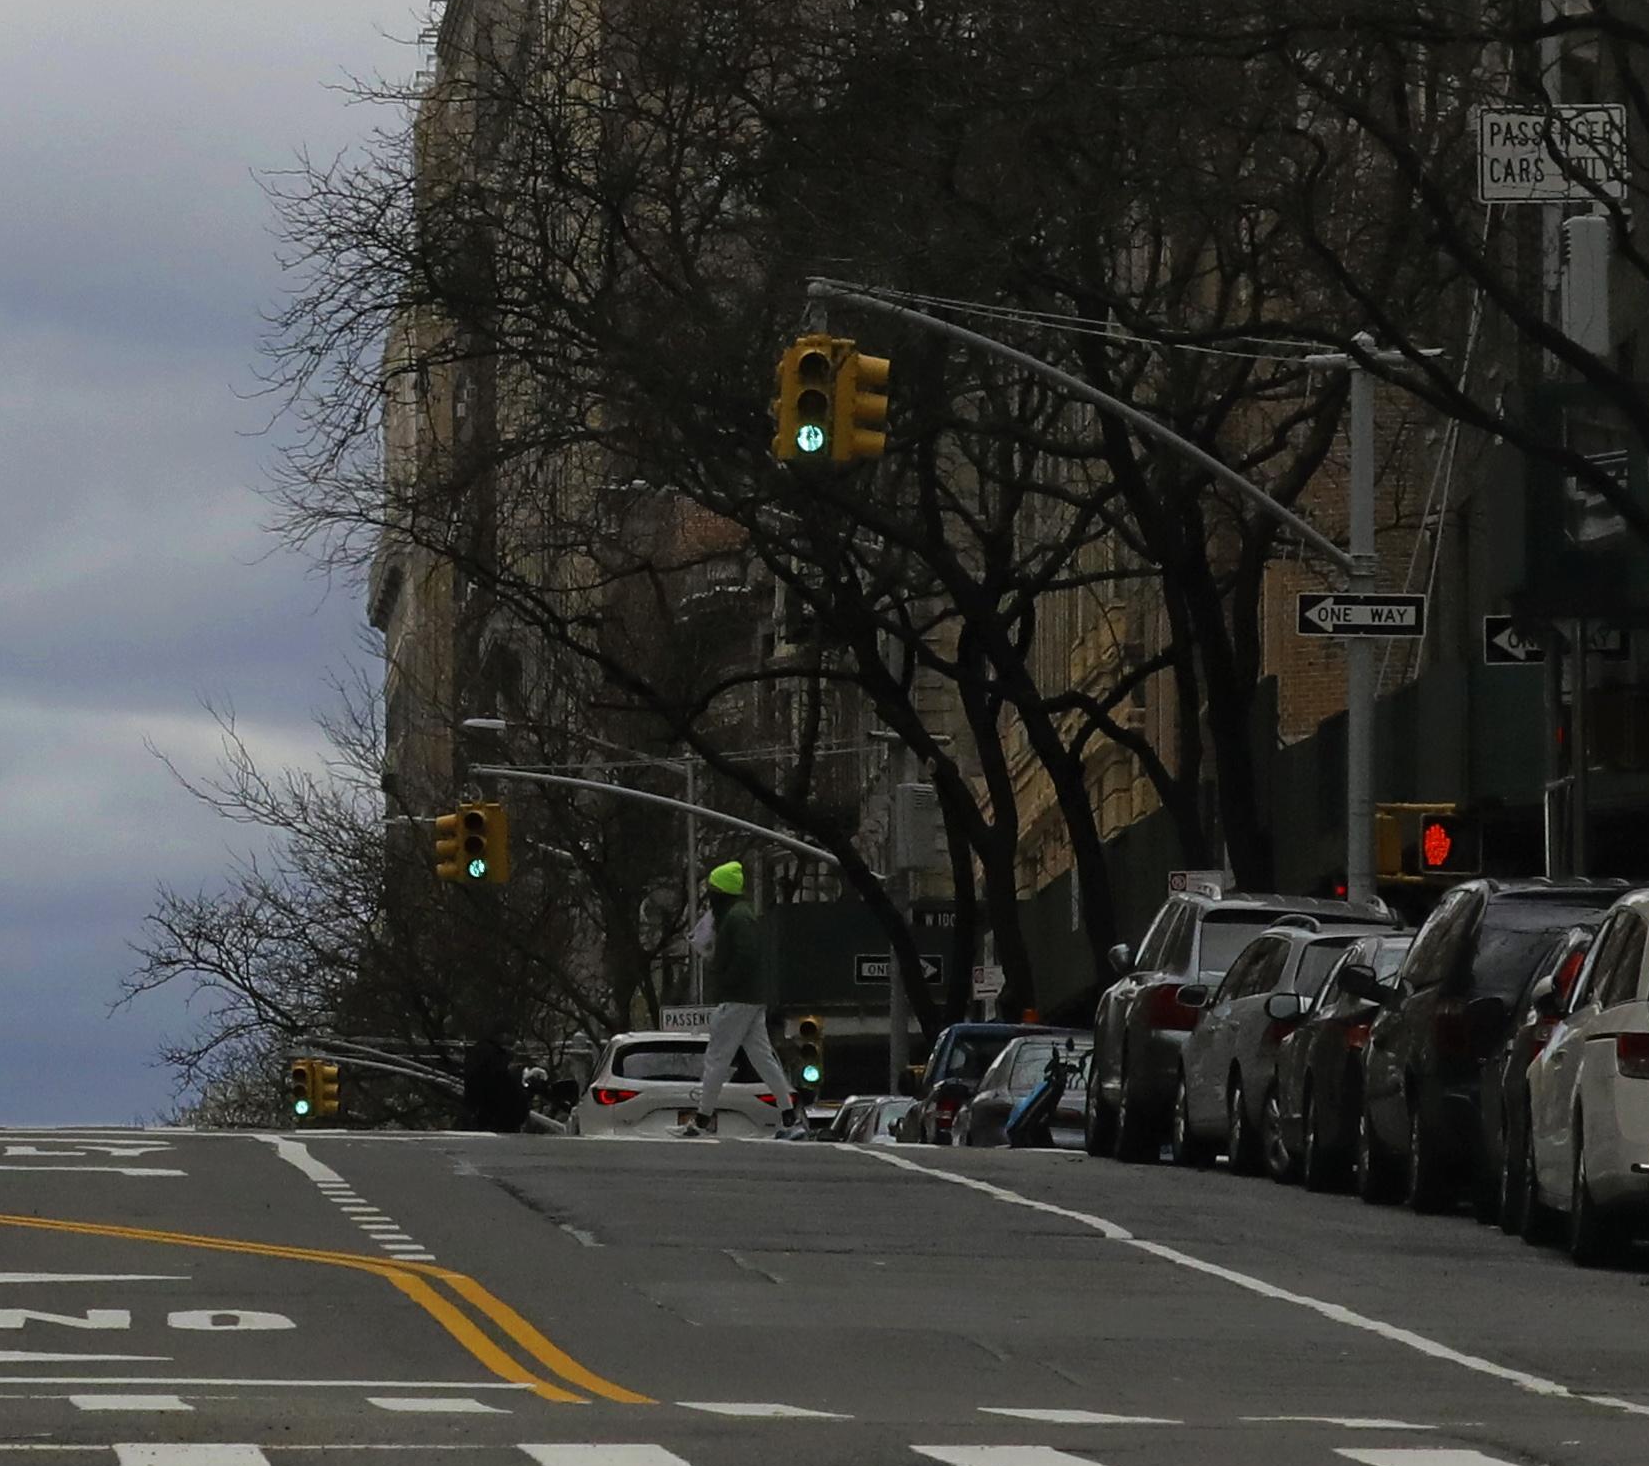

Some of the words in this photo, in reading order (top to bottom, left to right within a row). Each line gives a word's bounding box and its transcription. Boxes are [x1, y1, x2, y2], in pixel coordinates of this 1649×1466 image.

[1490, 158, 1545, 183] CARS
[1318, 607, 1352, 623] ONE
[1370, 608, 1408, 623] WAY
